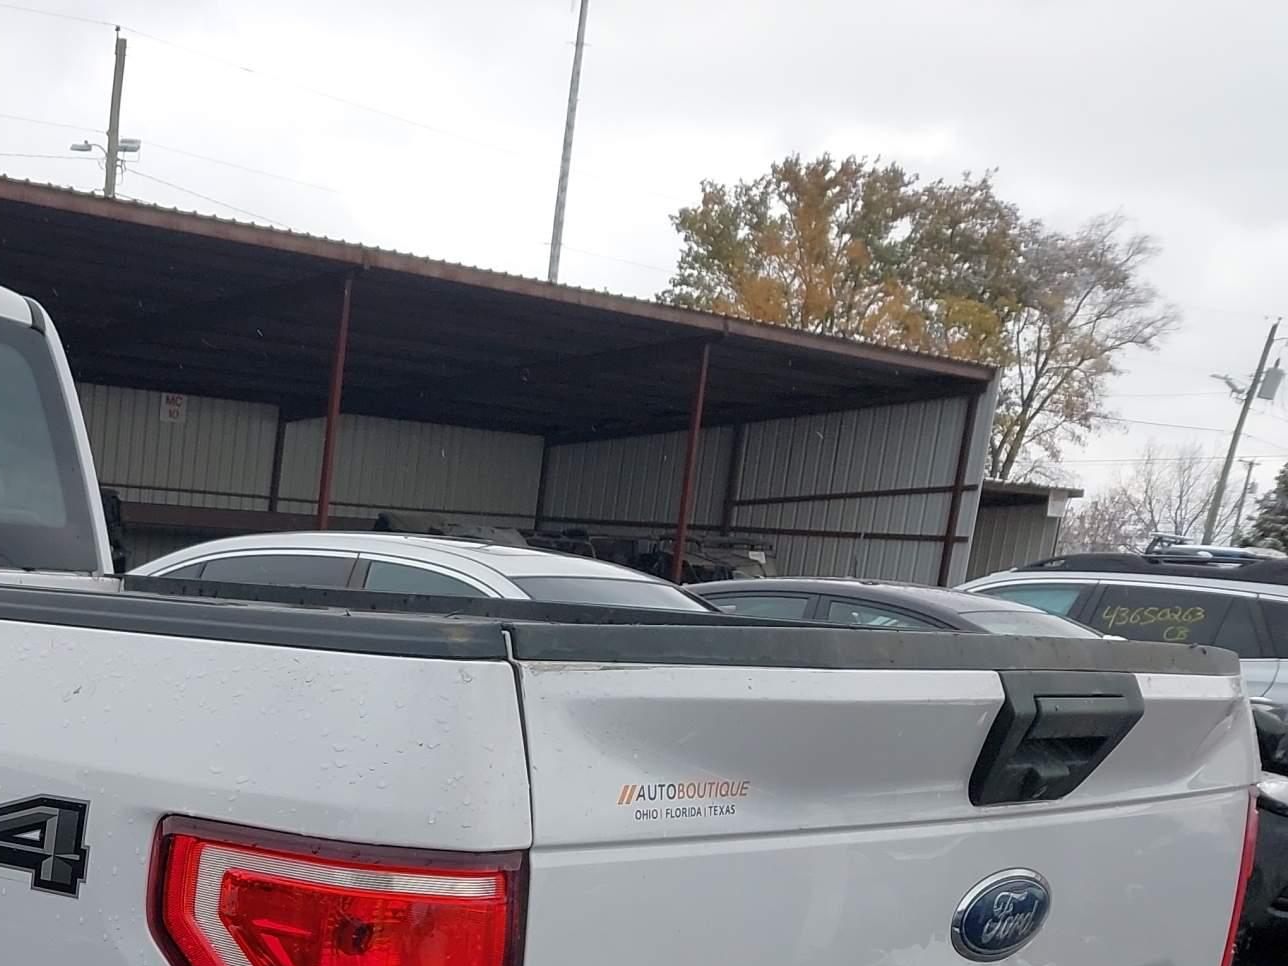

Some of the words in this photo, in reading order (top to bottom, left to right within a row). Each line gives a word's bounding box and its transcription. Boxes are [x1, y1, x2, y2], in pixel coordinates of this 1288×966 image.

[1102, 605, 1206, 629] 43650263
[634, 808, 658, 820] OHIO
[665, 807, 702, 819] FLORIDA
[708, 804, 736, 816] TEXAS
[981, 890, 1039, 944] Ford
